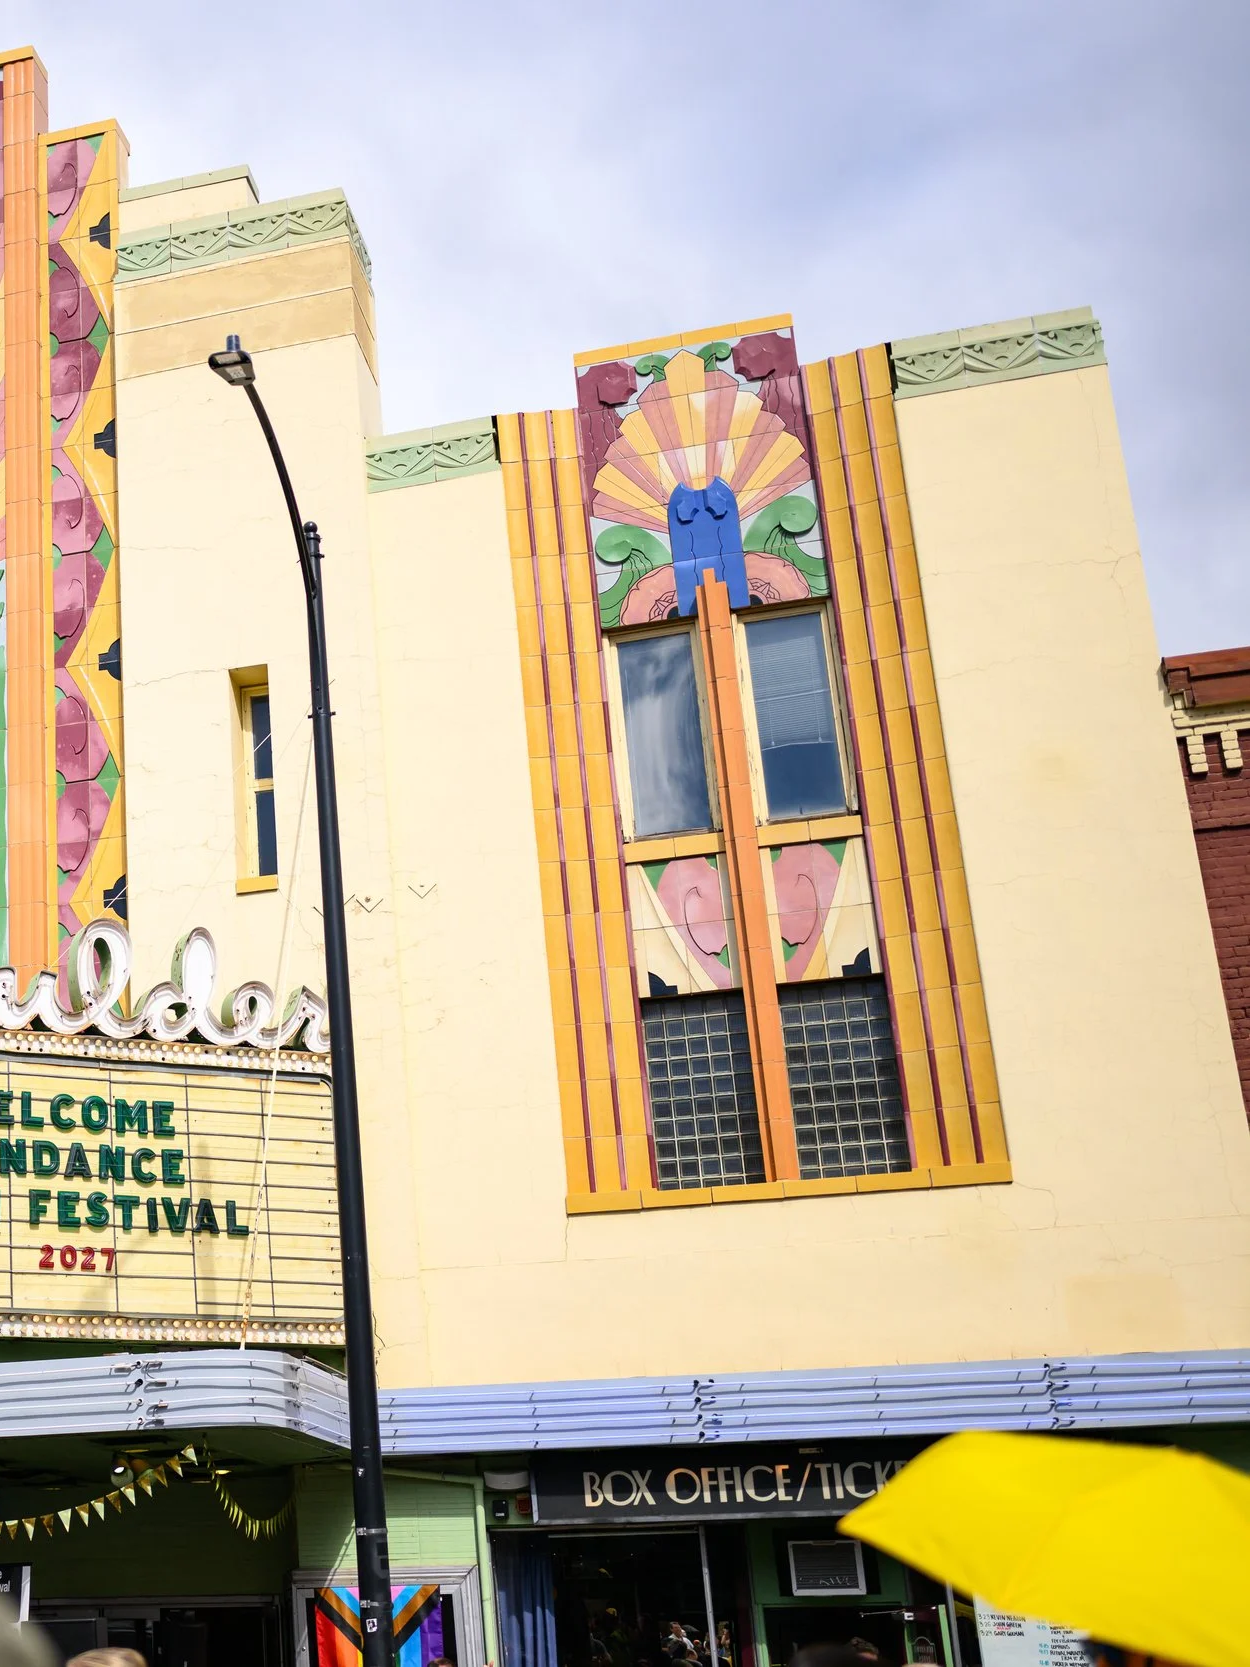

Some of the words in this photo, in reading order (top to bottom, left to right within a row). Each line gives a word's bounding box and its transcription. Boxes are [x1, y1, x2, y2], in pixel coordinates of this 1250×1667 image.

[29, 1189, 250, 1236] FESTIVAL
[39, 1244, 116, 1271] 2027
[583, 1469, 656, 1507] BOX
